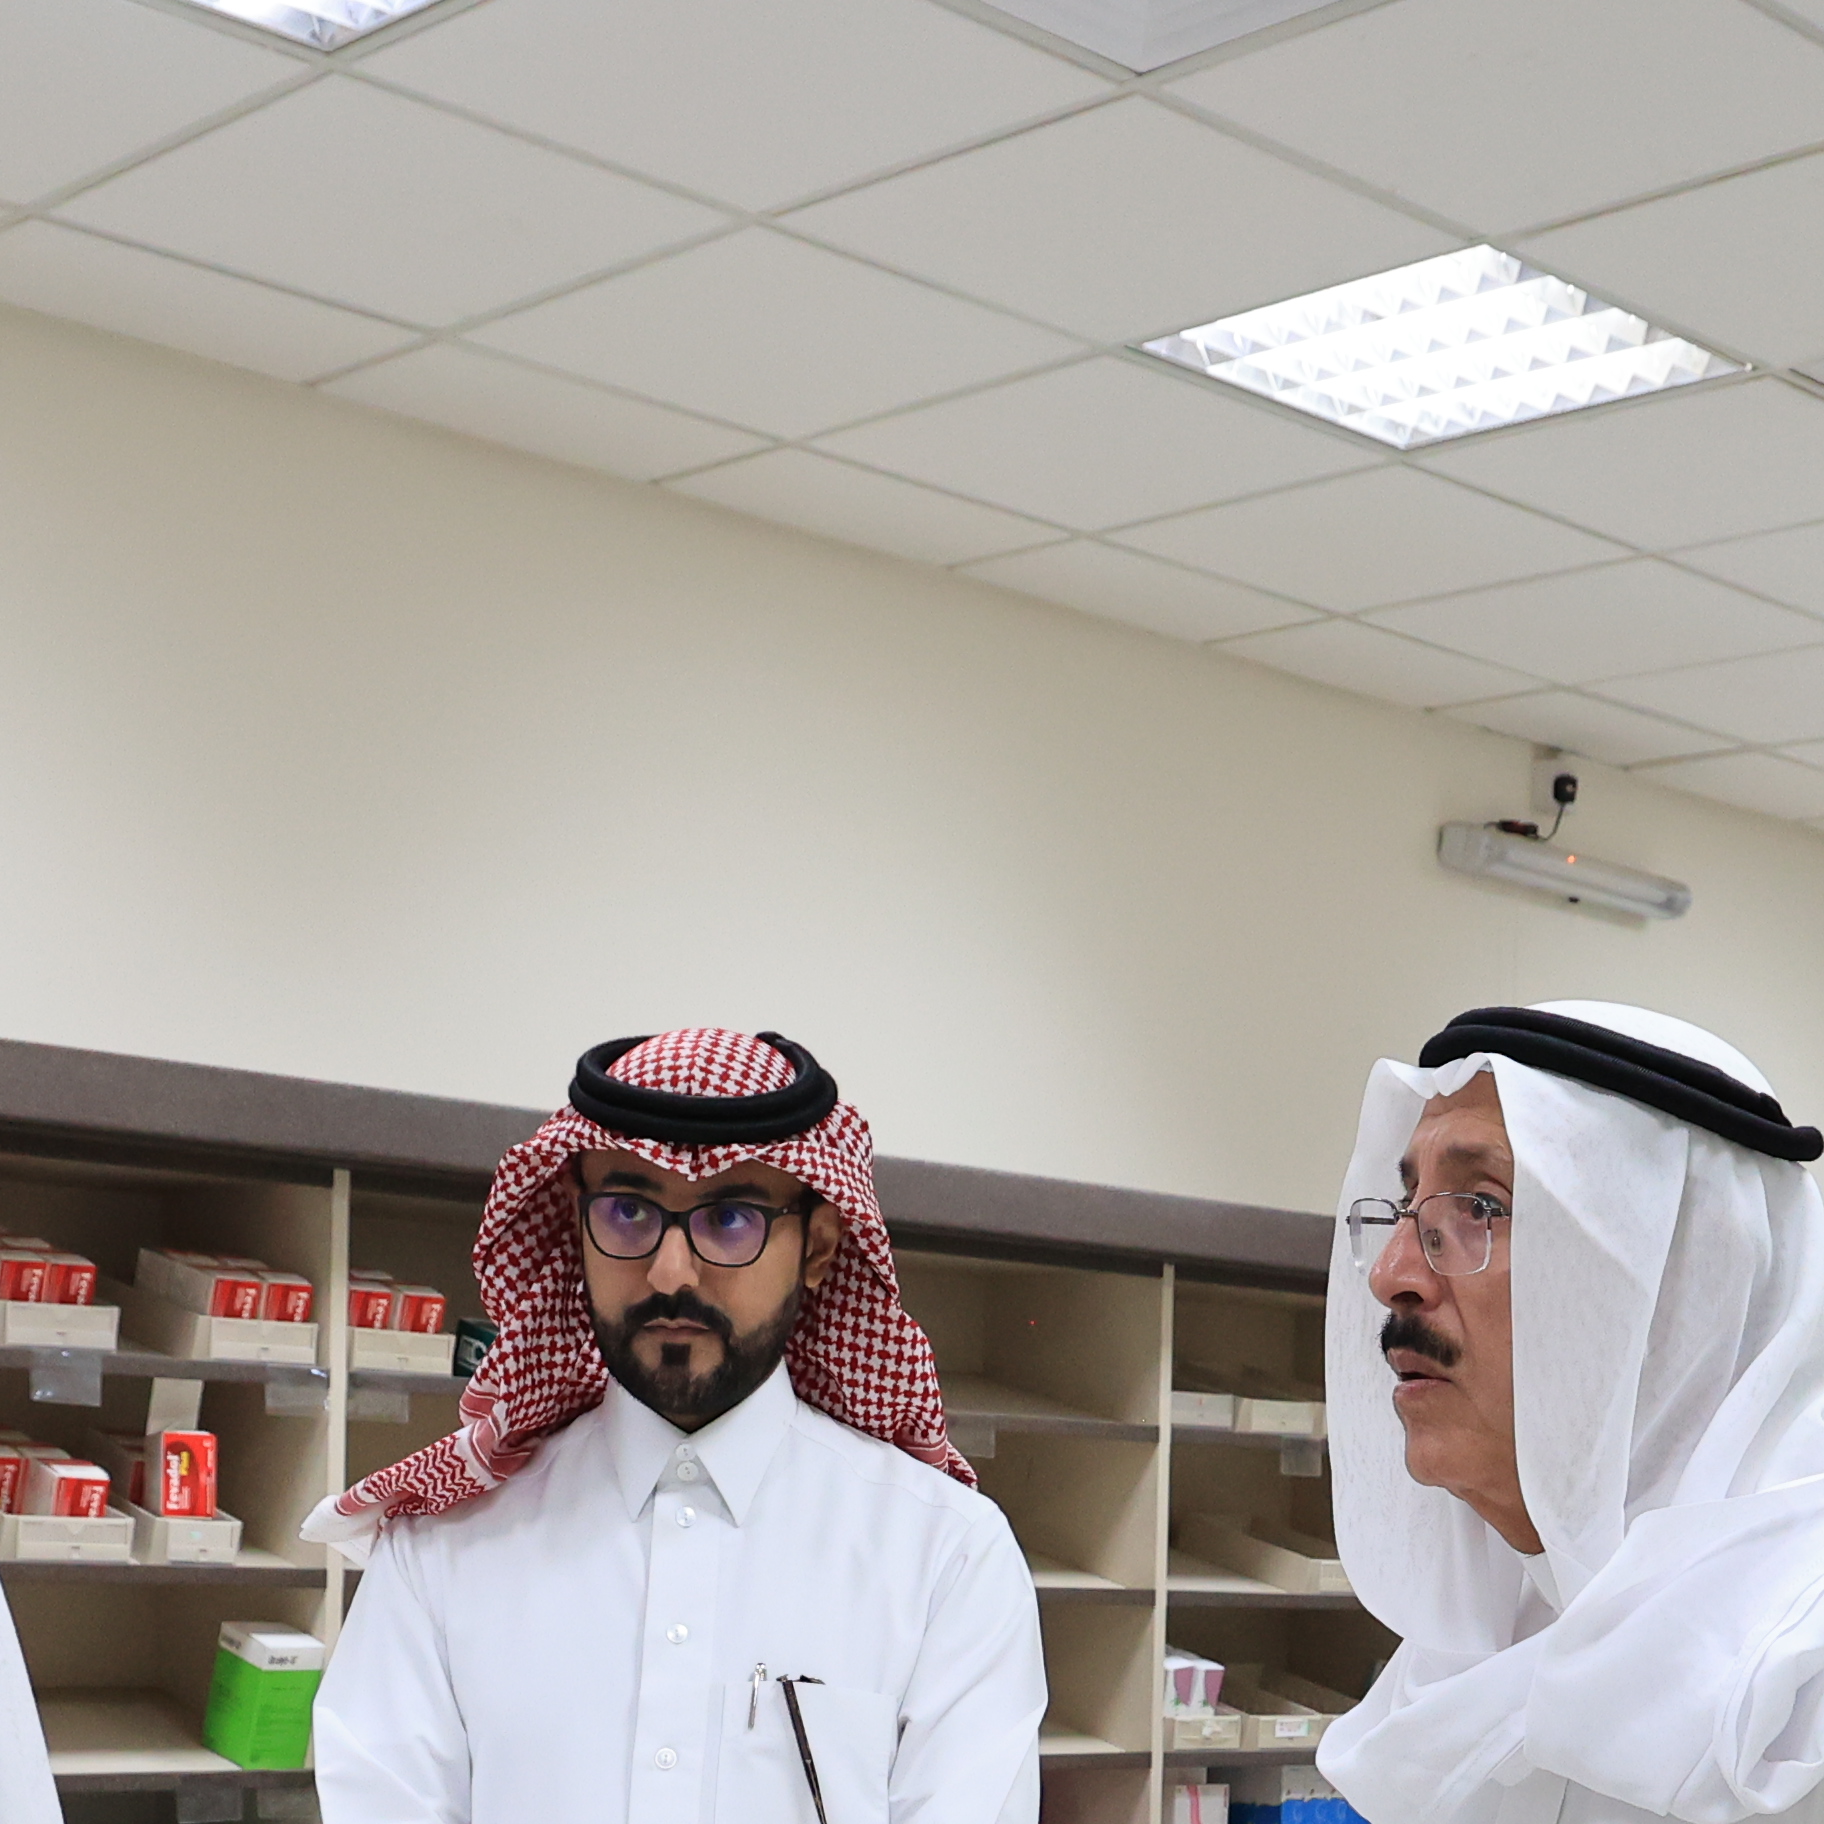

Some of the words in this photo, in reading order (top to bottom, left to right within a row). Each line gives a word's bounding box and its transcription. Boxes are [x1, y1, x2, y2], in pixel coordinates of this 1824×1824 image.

[28, 1268, 43, 1302] Feva
[77, 1272, 92, 1305] Feva
[241, 1288, 256, 1319] Feva
[293, 1292, 310, 1322] Feva
[166, 1453, 180, 1510] Fevadol
[88, 1485, 106, 1517] Feva
